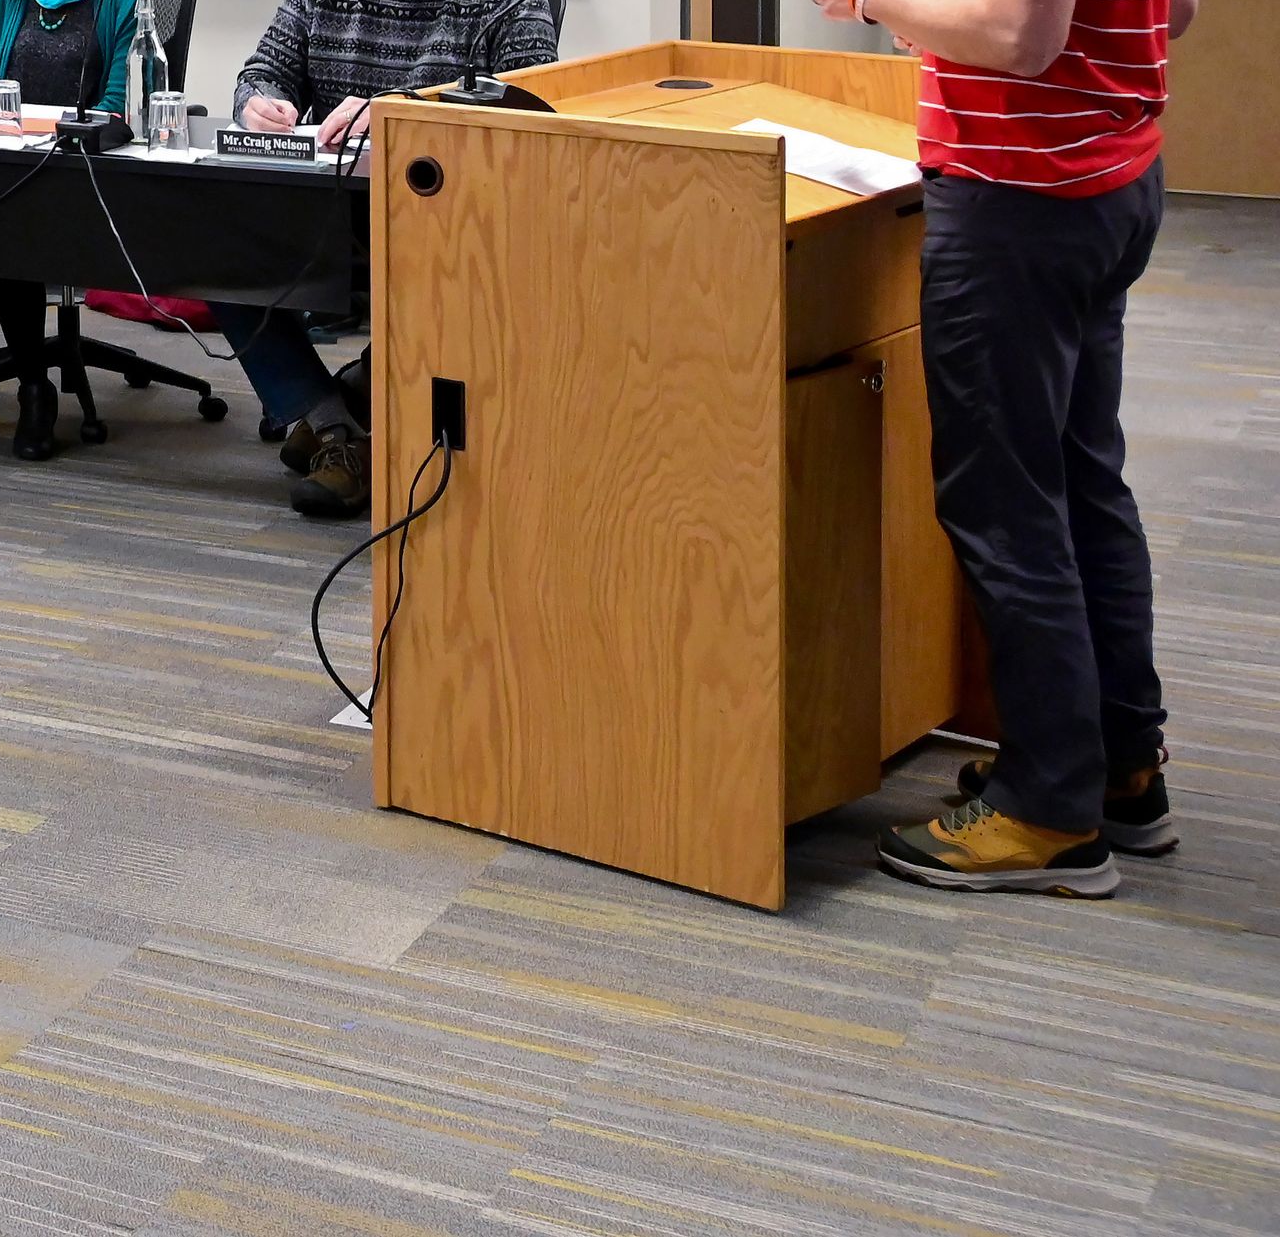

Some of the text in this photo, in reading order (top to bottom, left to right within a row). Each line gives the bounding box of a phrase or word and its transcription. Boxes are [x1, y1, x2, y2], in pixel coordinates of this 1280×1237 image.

[223, 134, 310, 151] Mr. Craig Nelson
